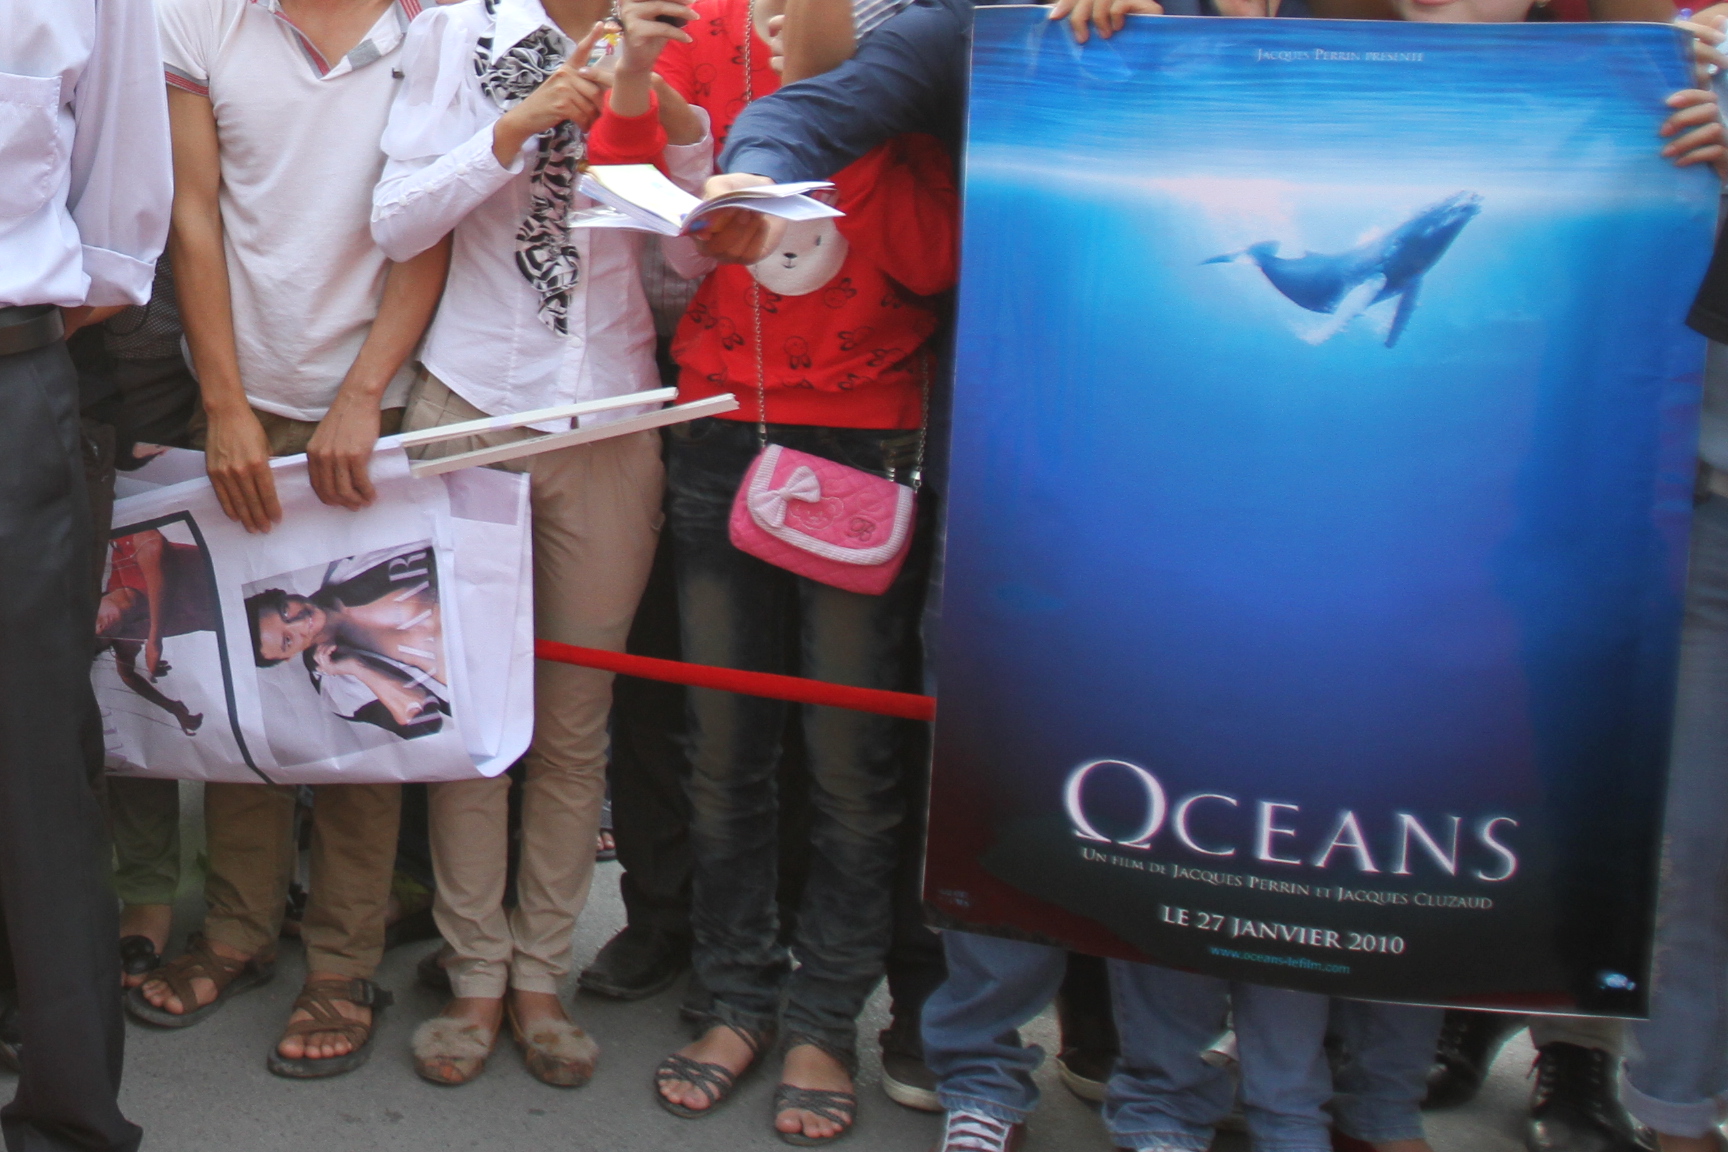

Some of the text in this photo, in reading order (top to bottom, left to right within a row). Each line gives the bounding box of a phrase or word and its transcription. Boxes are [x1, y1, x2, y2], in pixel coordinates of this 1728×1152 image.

[1314, 48, 1361, 61] PERRIN
[1063, 759, 1519, 882] OCEANS
[1082, 846, 1107, 863] UN
[1111, 854, 1145, 871] FILM
[1149, 861, 1167, 875] DE
[1172, 864, 1243, 886] JACQUES
[1248, 875, 1310, 896] PERRIN
[1338, 887, 1409, 906] JACQUES
[1414, 892, 1493, 909] CLUZAUD
[1162, 904, 1405, 955] LE 27 JANVIER 2010
[1208, 946, 1351, 974] www.oceans-lefilm.com
